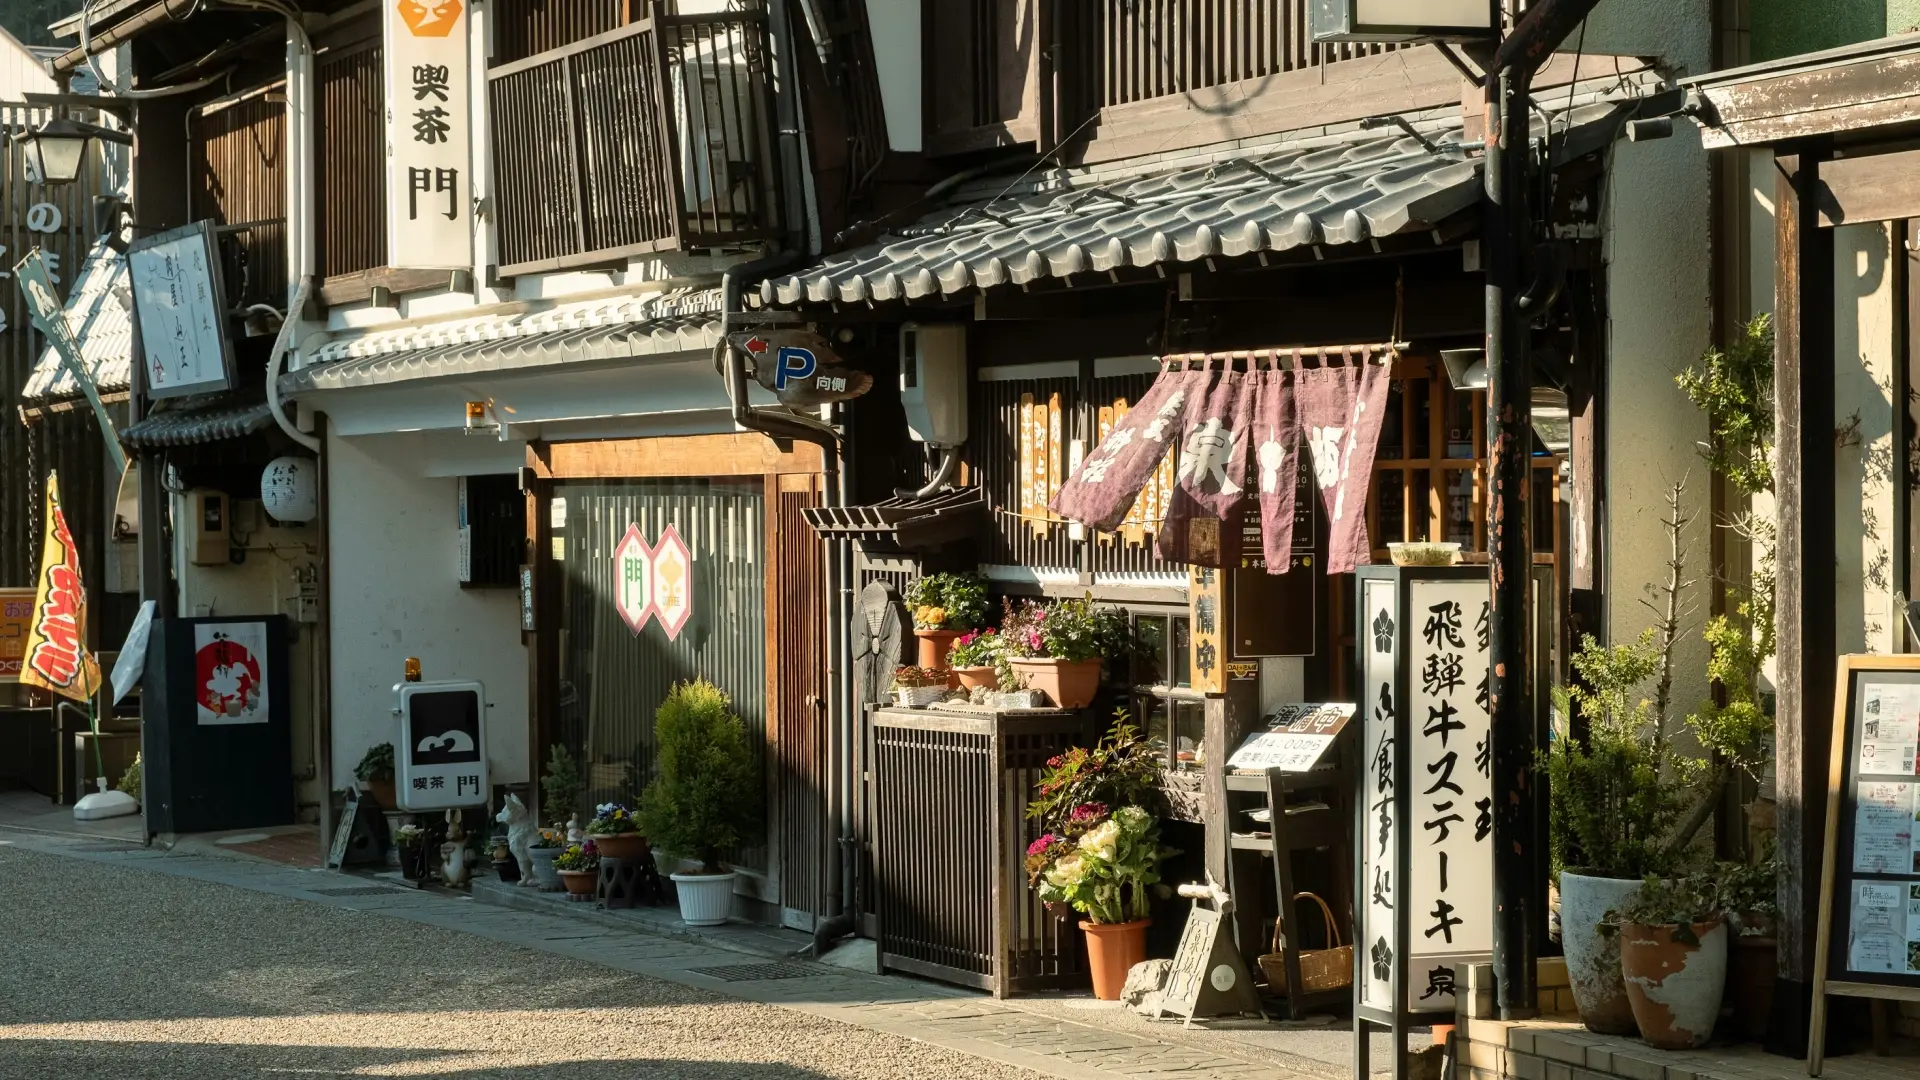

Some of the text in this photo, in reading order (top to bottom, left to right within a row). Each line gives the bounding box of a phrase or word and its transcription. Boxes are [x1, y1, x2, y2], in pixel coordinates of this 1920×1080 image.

[408, 64, 459, 221] 喫茶 門
[775, 346, 816, 391] P
[816, 376, 846, 392] 向側
[624, 556, 643, 610] 門
[1267, 705, 1343, 733] 準備中
[413, 775, 480, 797] 喫茶 門
[1422, 600, 1467, 944] 飛騨牛ステーキ
